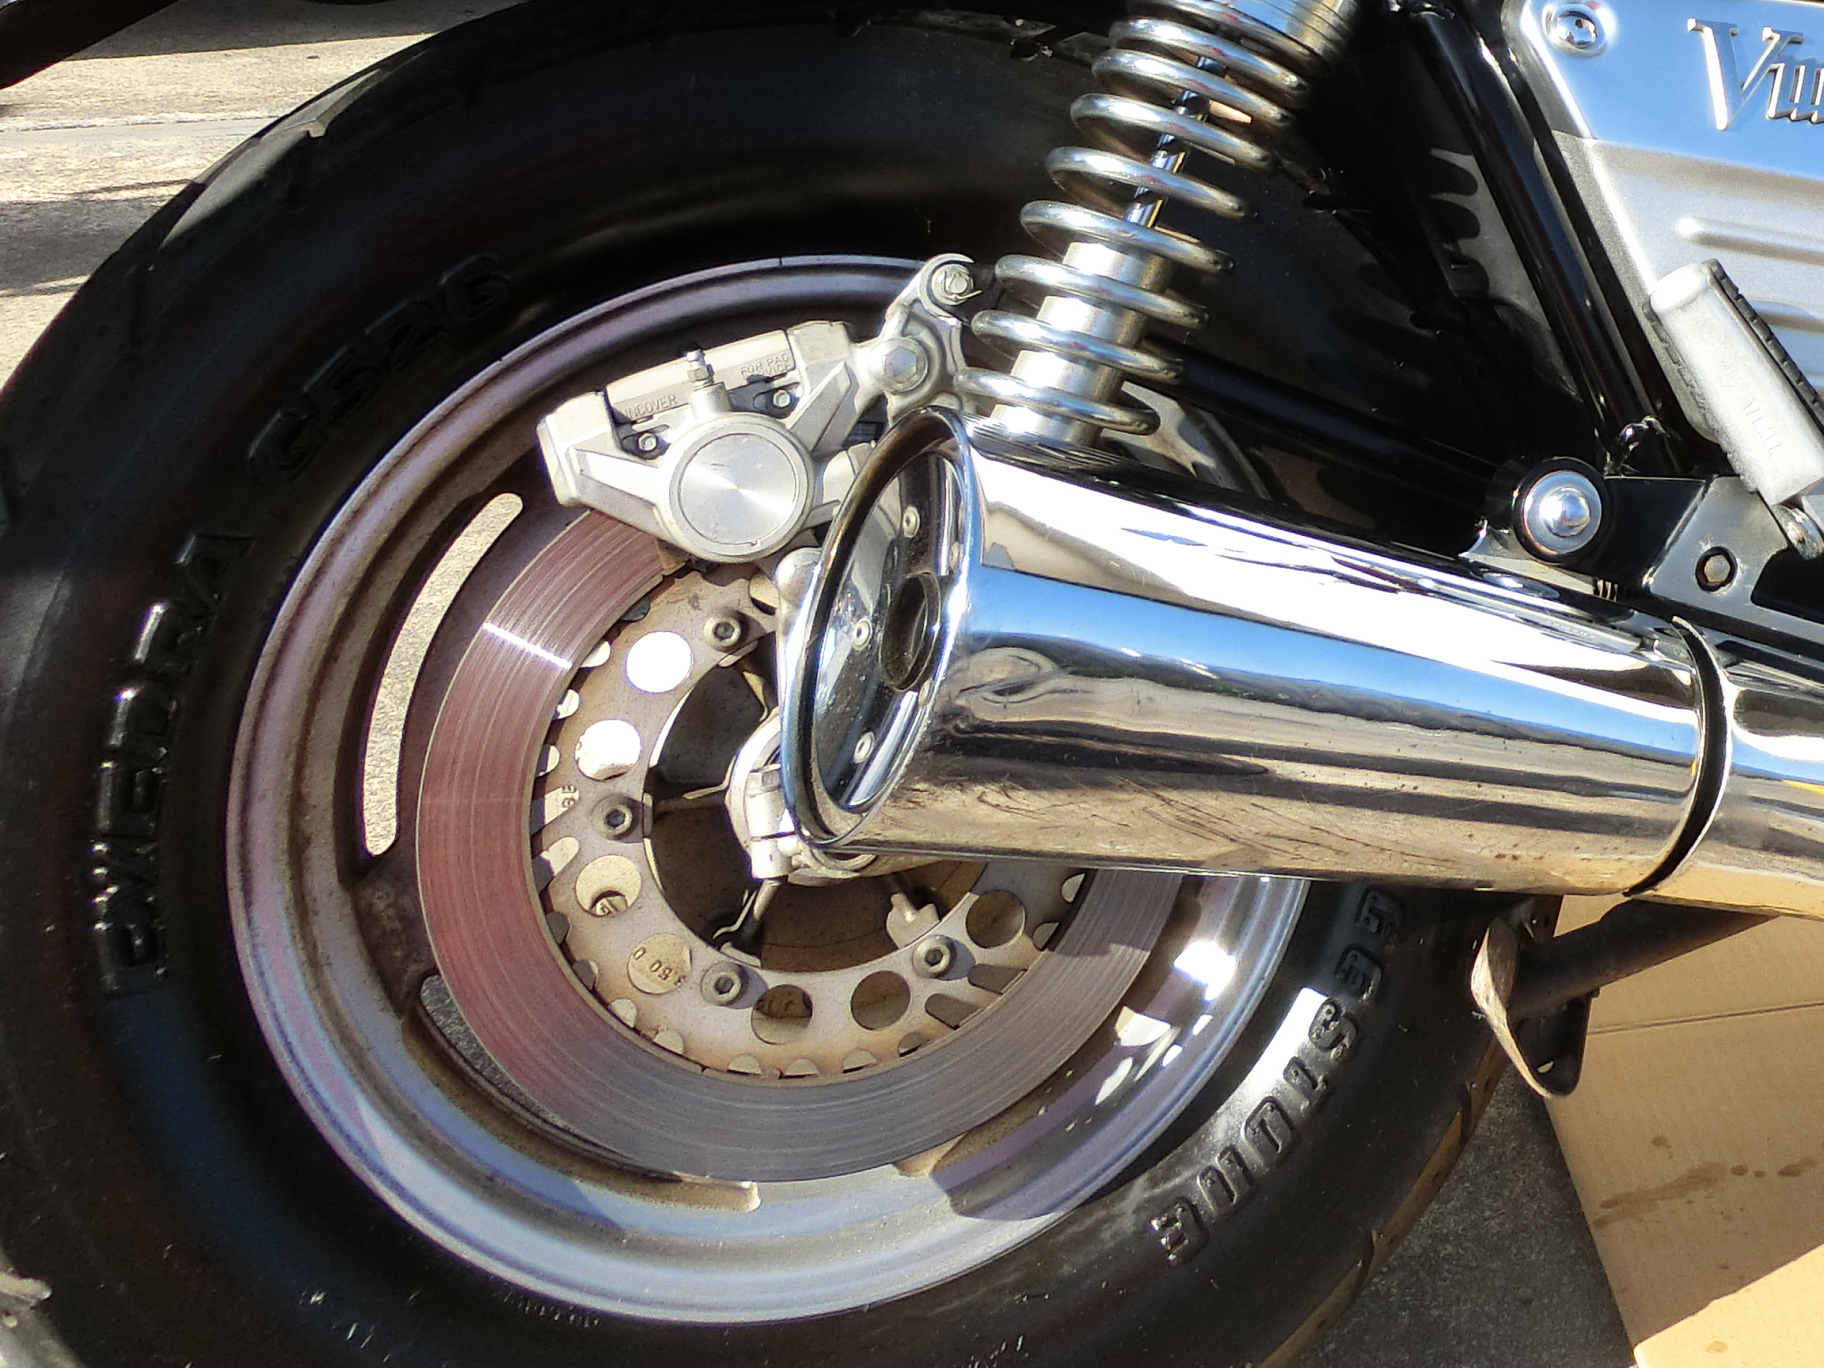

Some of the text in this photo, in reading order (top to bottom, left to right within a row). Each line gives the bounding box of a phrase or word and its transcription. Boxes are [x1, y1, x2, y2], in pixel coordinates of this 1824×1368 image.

[740, 363, 763, 377] FOR
[767, 352, 791, 369] PAD
[90, 251, 512, 996] EXEDRA G526
